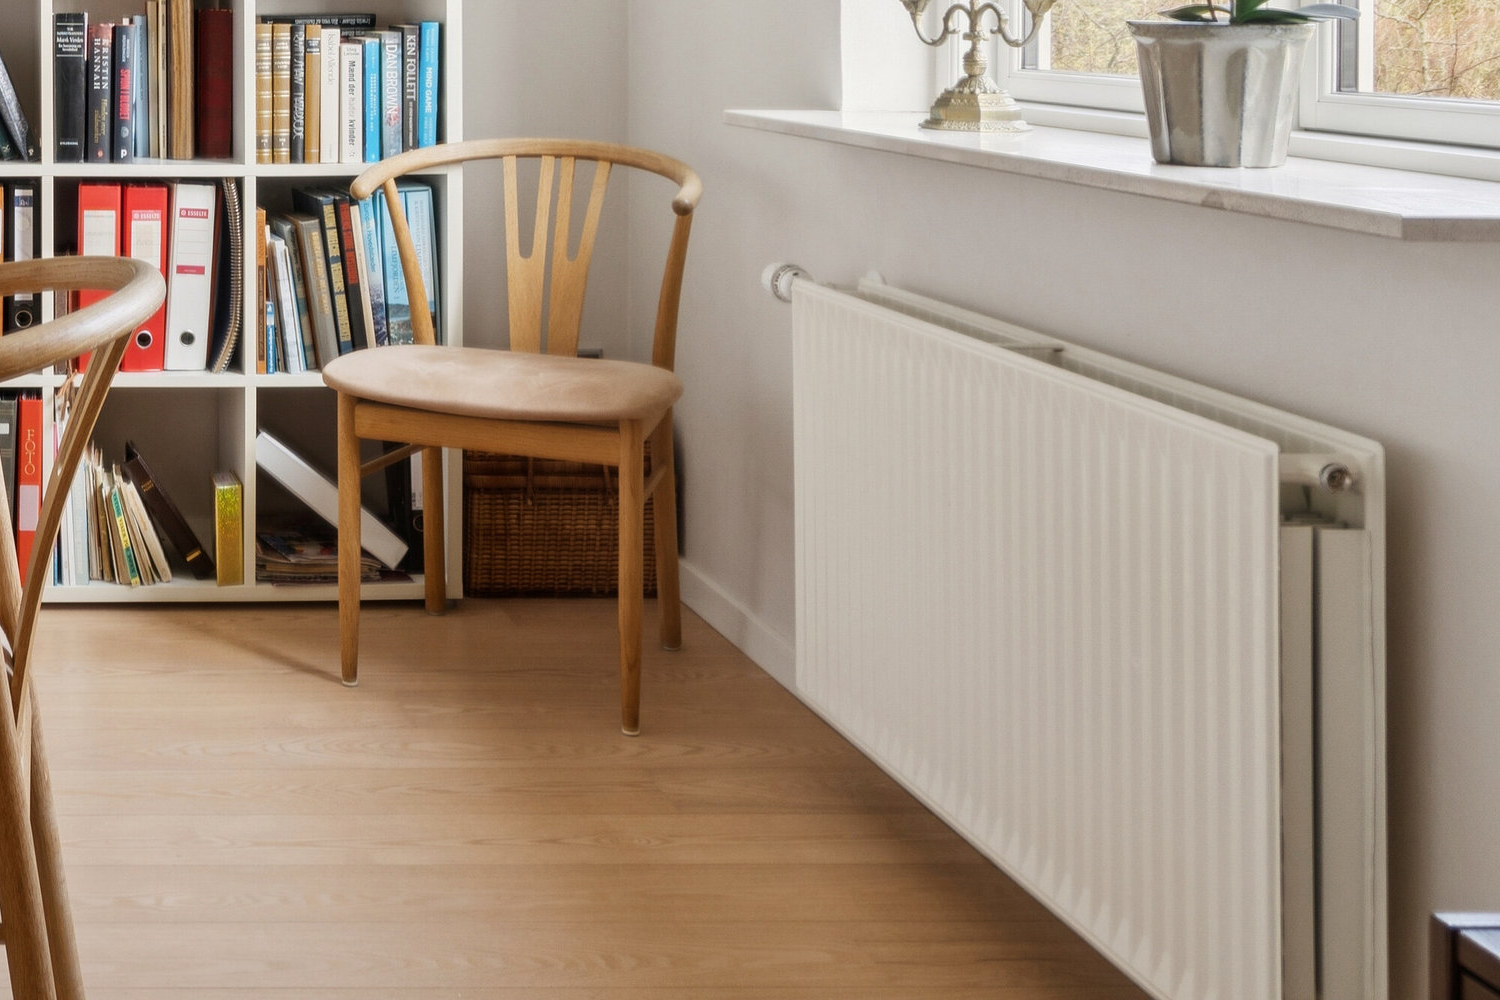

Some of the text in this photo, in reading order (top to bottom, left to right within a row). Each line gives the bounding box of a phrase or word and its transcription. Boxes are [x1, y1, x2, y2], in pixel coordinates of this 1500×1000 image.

[93, 38, 101, 90] HANNAH
[101, 38, 109, 90] KRISTIN
[327, 33, 336, 85] Isabel Allende
[348, 60, 356, 82] Mænd
[386, 44, 398, 114] DAN BROWN
[406, 34, 416, 101] KEN FOLLETT
[425, 67, 434, 88] MIND
[348, 83, 356, 96] der
[424, 89, 433, 113] GAME
[348, 119, 356, 146] kvinder
[24, 428, 36, 476] FOTO
